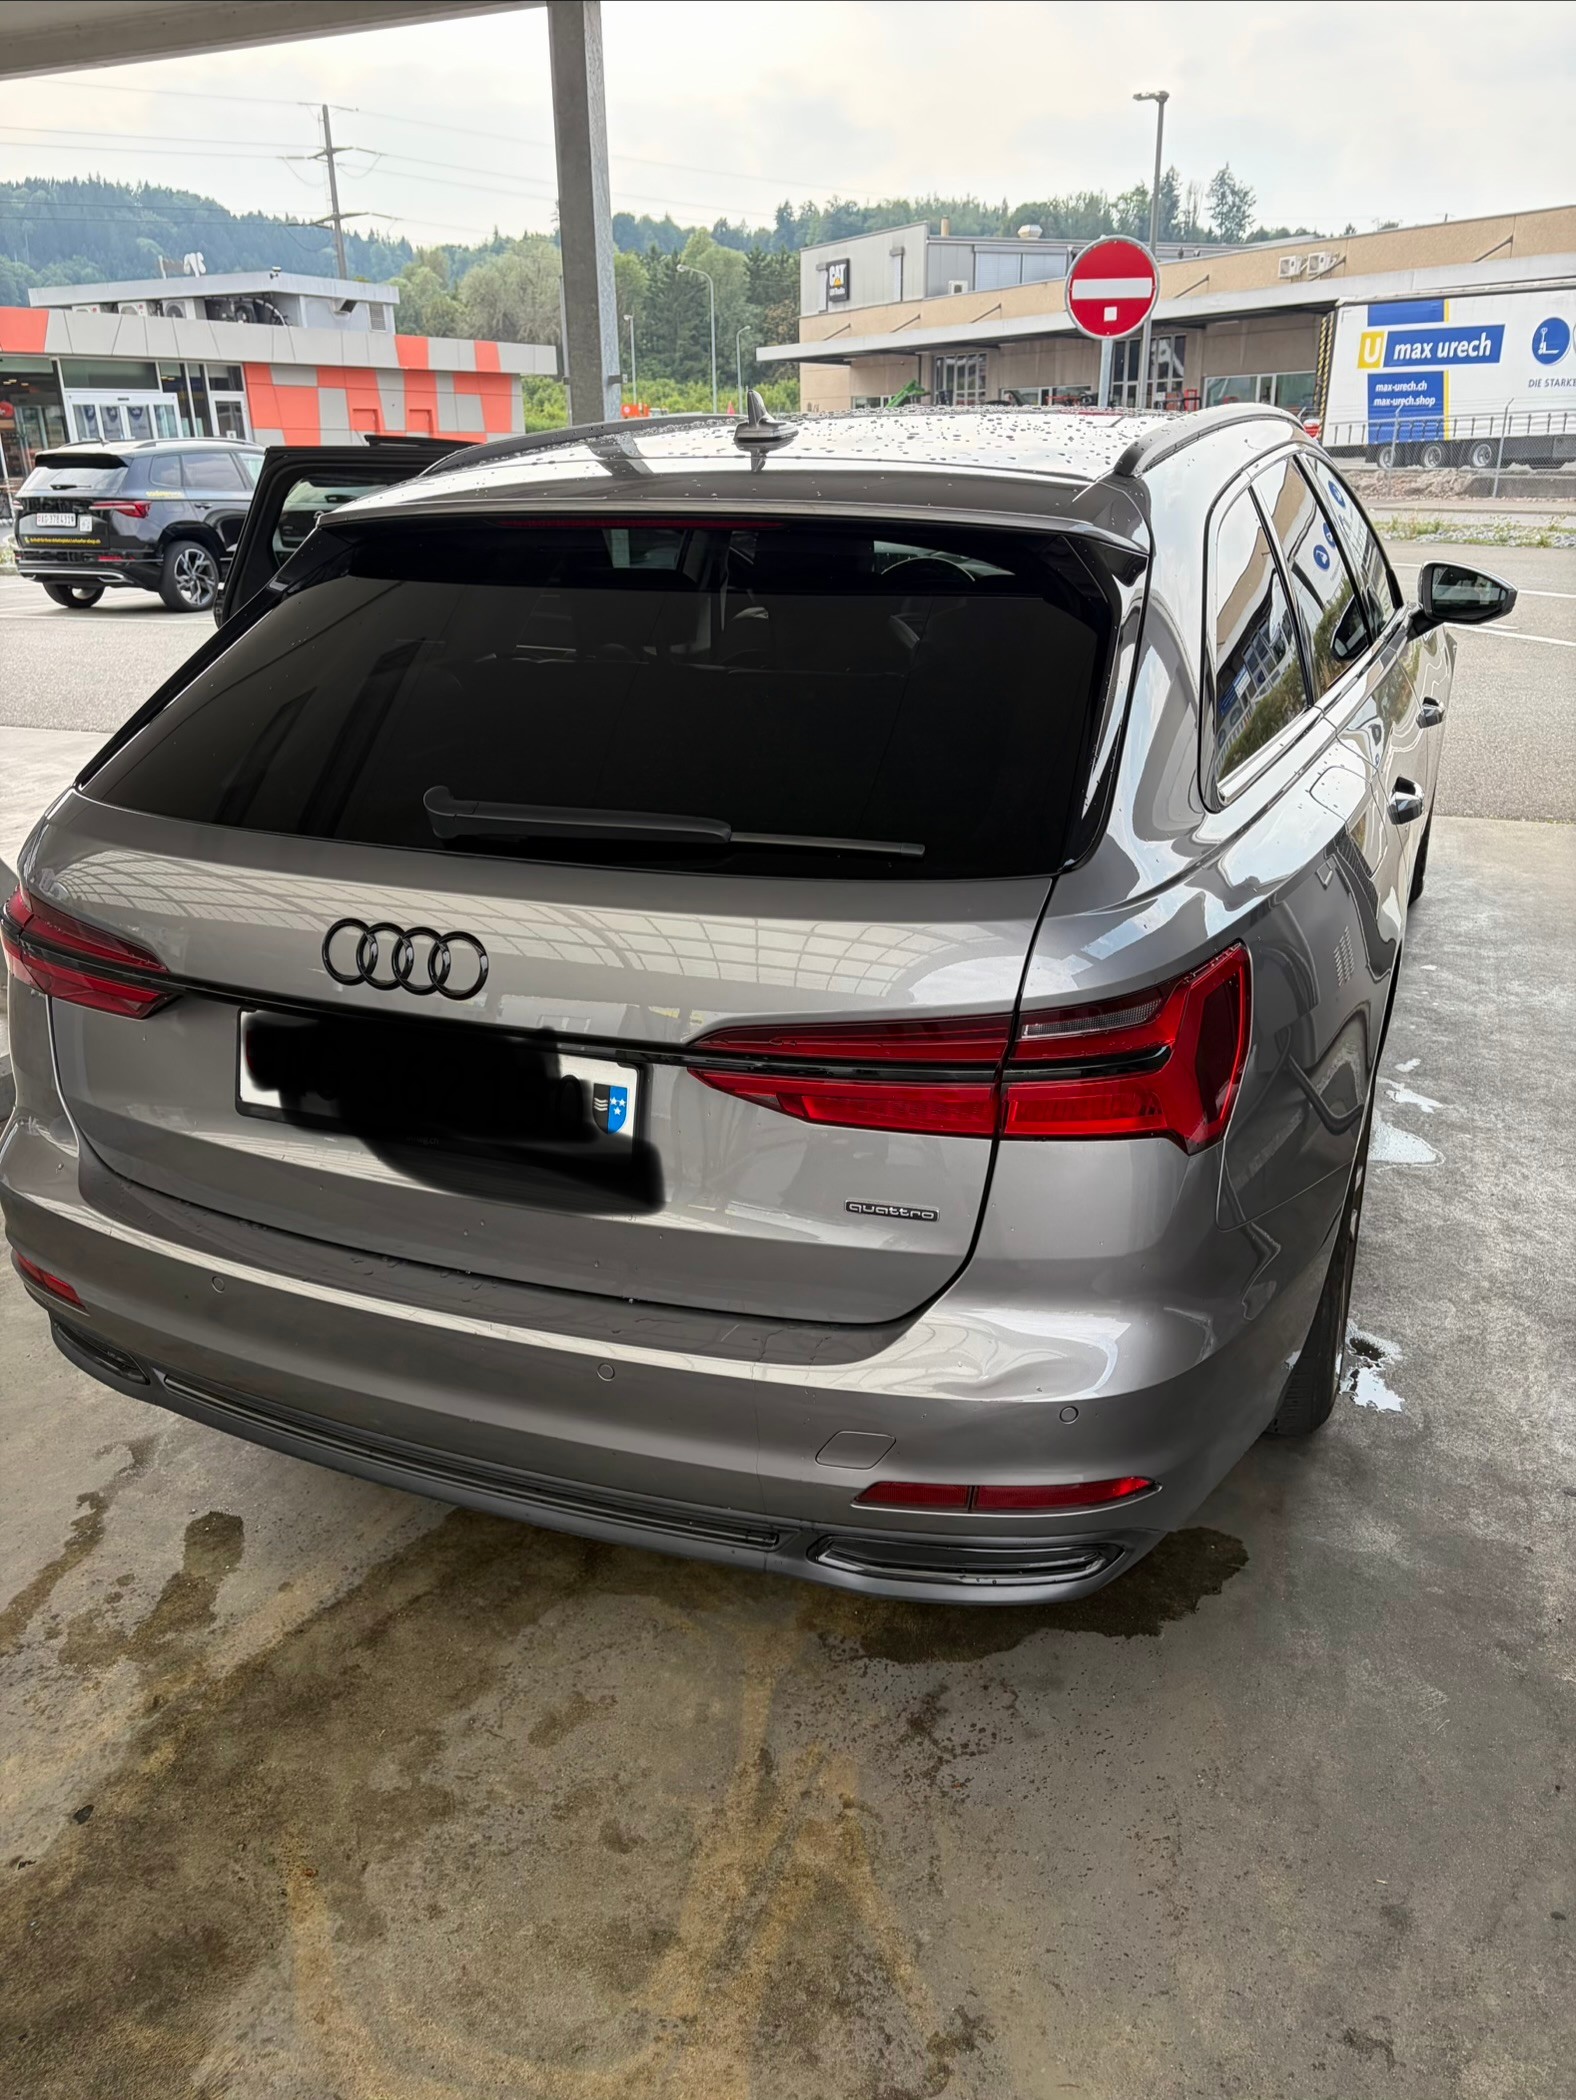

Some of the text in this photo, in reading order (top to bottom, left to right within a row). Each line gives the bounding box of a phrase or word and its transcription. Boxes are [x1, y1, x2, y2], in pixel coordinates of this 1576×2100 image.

[829, 264, 846, 286] CAT
[1393, 332, 1492, 360] max urech
[1375, 380, 1428, 392] max-urech.ch
[1528, 378, 1542, 388] DIE
[1373, 395, 1436, 408] max-urech.shop
[848, 1203, 935, 1220] quattro
